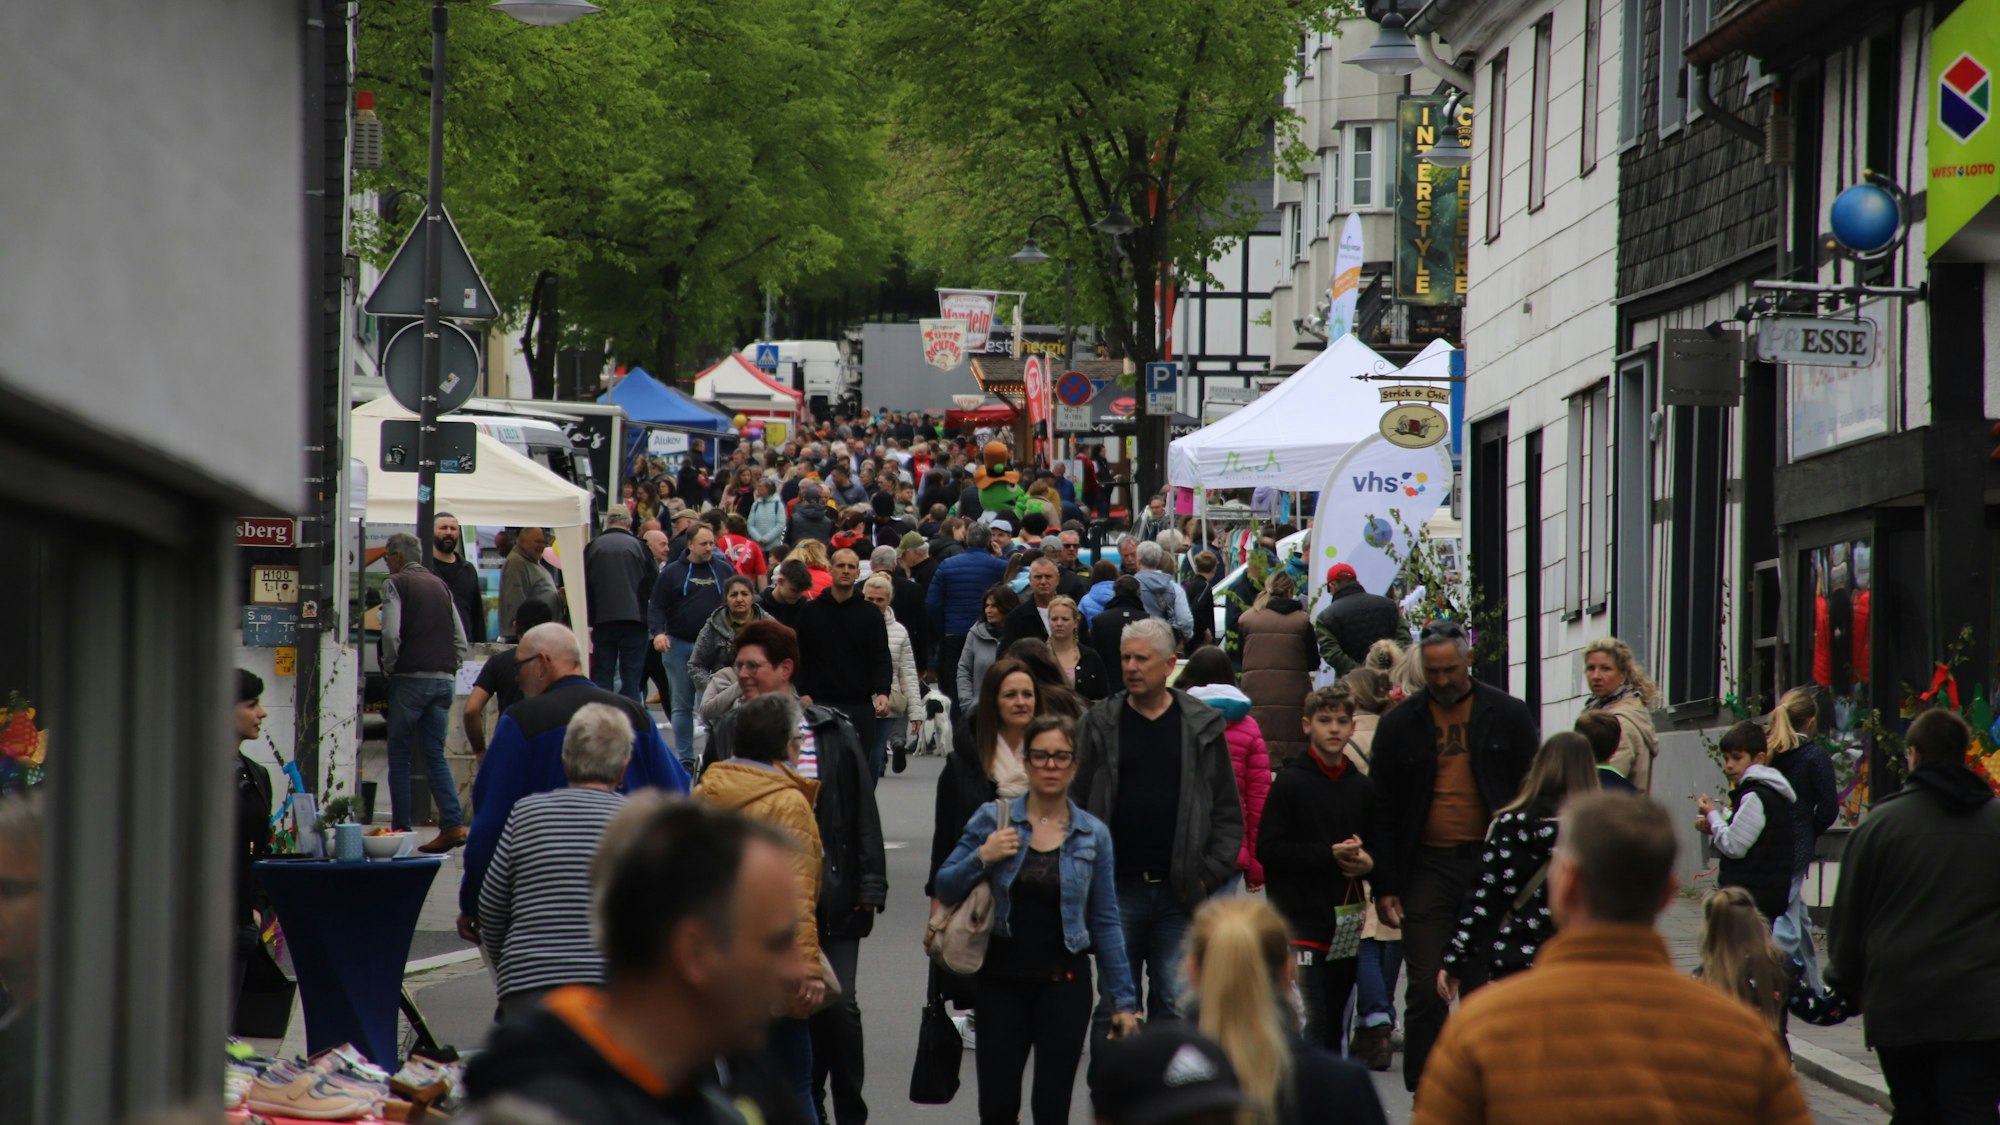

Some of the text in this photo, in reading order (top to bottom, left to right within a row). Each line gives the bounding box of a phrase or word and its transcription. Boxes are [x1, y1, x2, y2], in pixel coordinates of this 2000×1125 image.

[1416, 107, 1433, 294] INTERSTYLE
[1766, 326, 1868, 355] PRESSE
[1153, 366, 1170, 390] P
[1383, 389, 1411, 399] Strick
[1426, 388, 1447, 400] Chic
[653, 433, 681, 446] Alukov
[1352, 471, 1398, 493] vhs
[263, 571, 289, 580] H100
[247, 611, 255, 620] S
